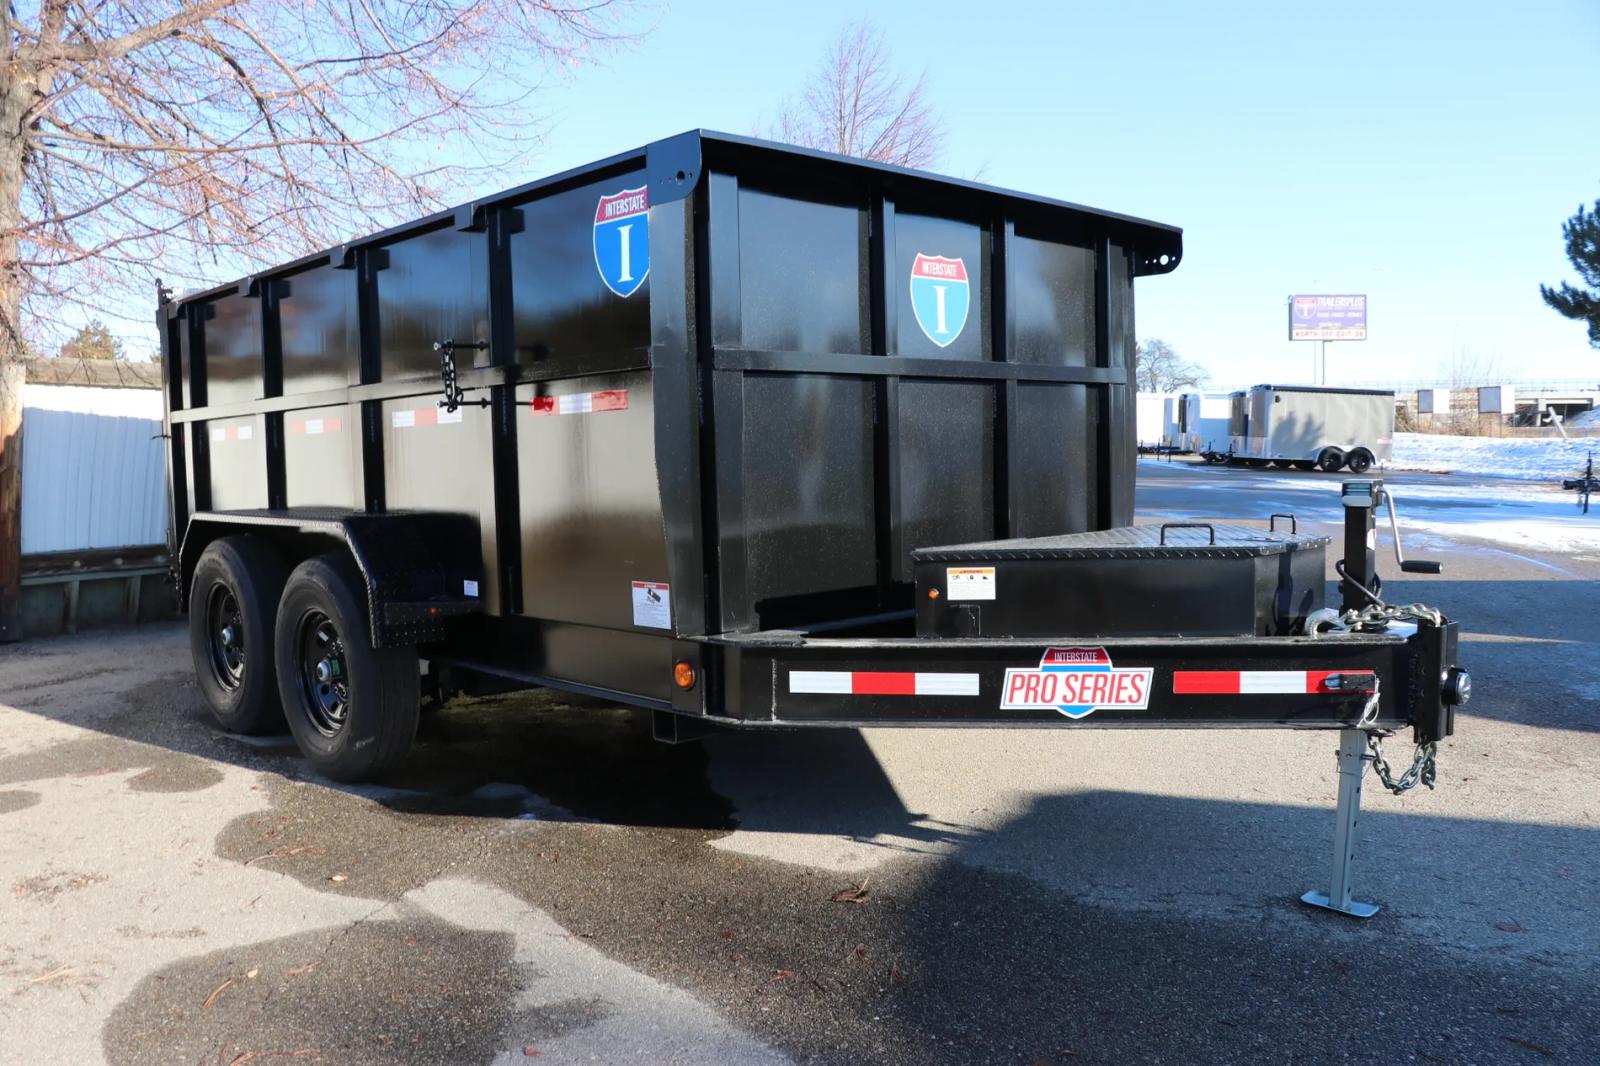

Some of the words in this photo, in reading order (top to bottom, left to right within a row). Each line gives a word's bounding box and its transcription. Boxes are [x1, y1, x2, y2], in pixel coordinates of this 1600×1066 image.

[605, 194, 645, 217] INTERSTATE
[617, 224, 634, 283] I
[922, 262, 958, 277] INTERSTATE
[933, 285, 950, 334] I
[1054, 652, 1098, 663] INTERSTATE
[1008, 673, 1058, 704] PRO
[1062, 673, 1145, 704] SERIES
